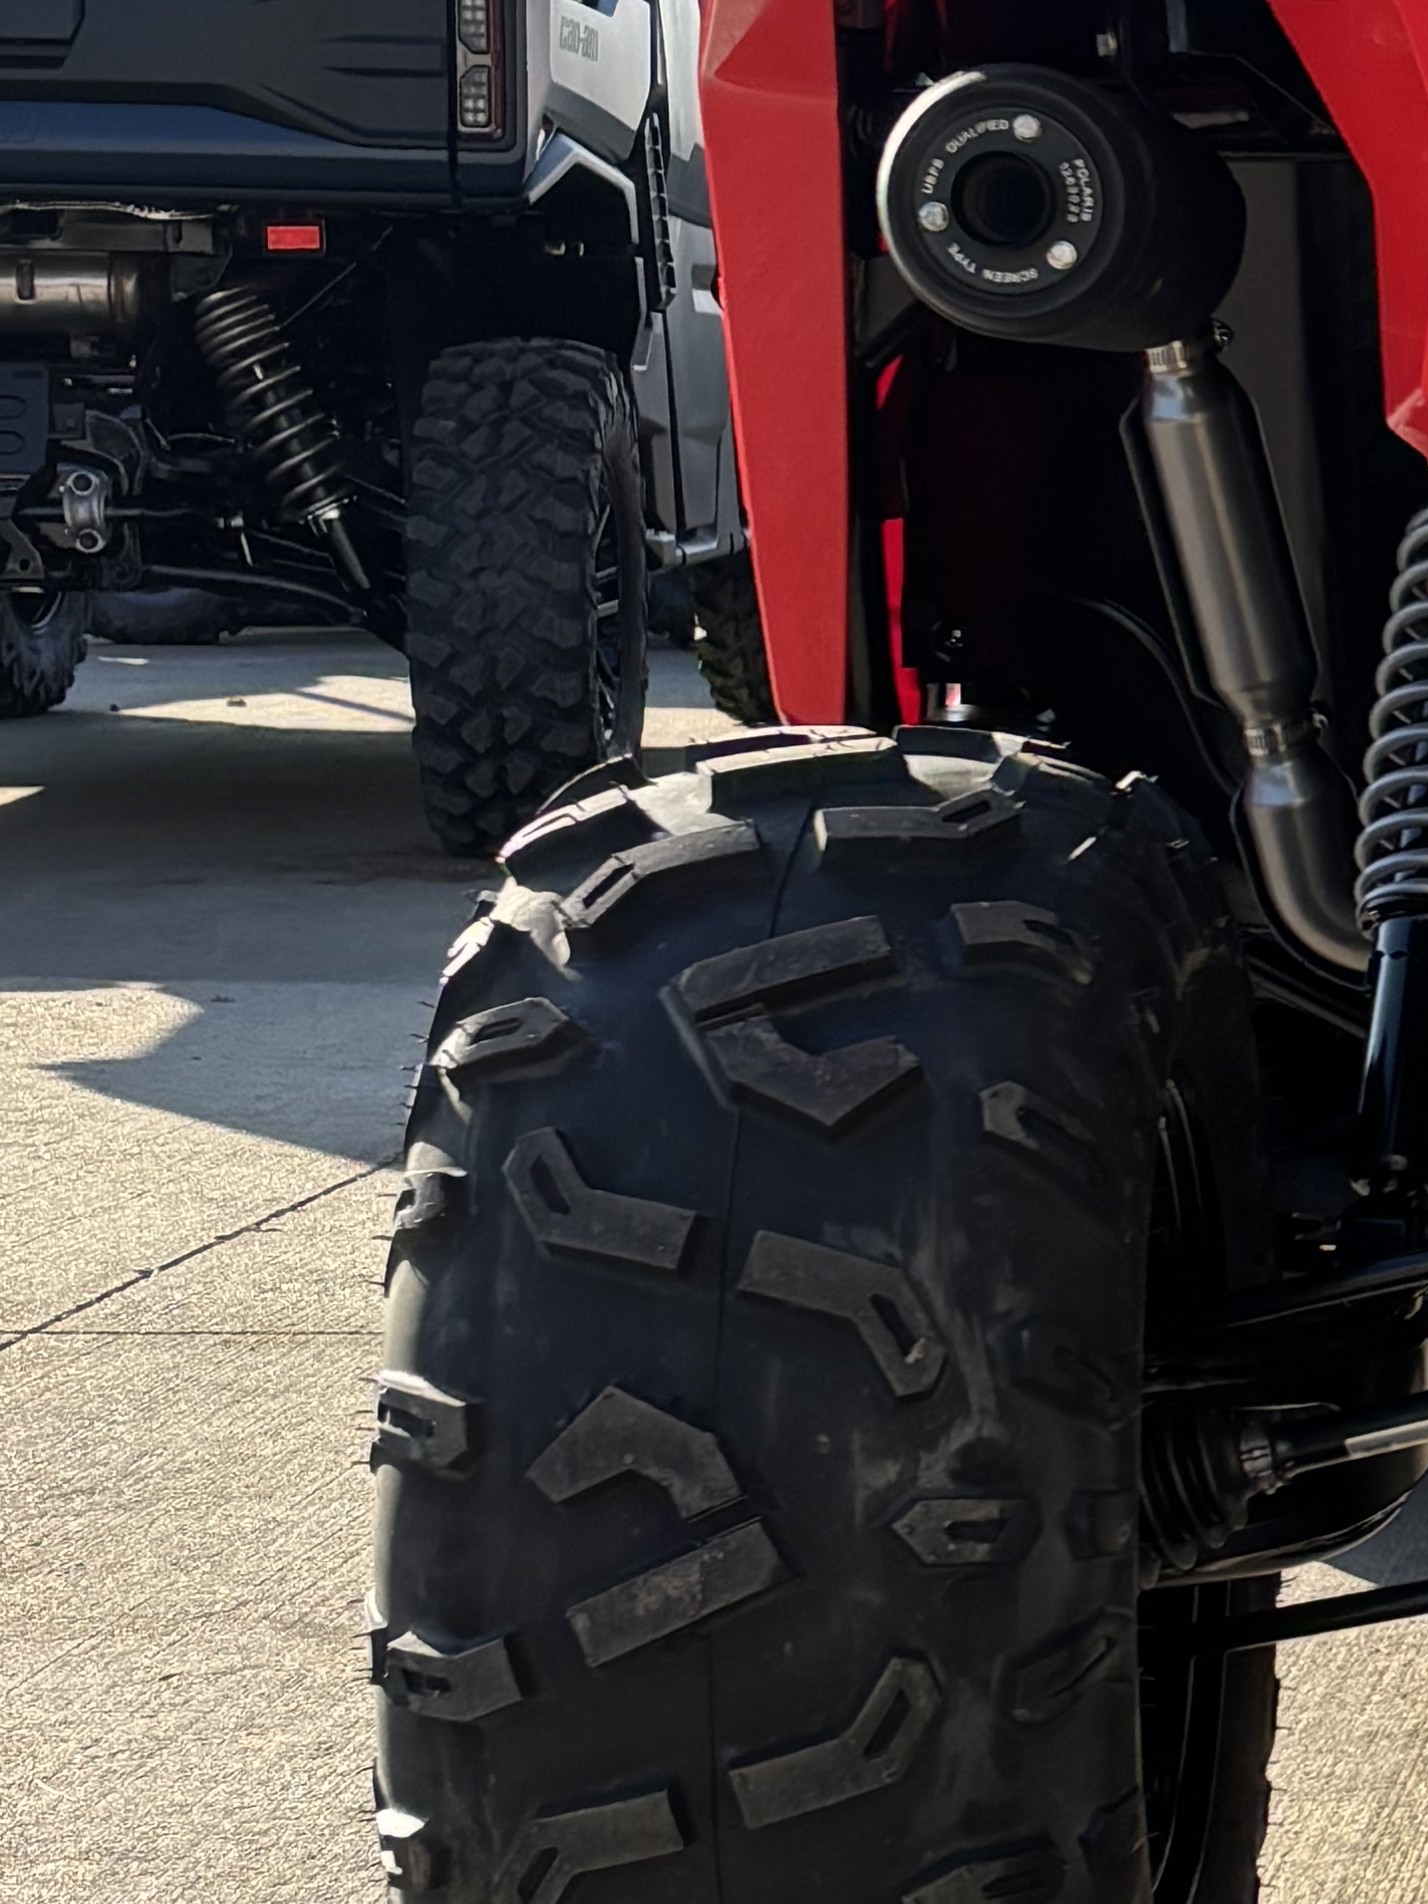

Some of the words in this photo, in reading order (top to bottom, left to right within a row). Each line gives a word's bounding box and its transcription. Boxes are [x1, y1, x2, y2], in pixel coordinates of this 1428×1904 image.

[944, 119, 1010, 154] QUALIFIED
[1072, 158, 1095, 222] POLARIS
[946, 242, 977, 274] TYPE
[981, 267, 1039, 284] SCREEN
